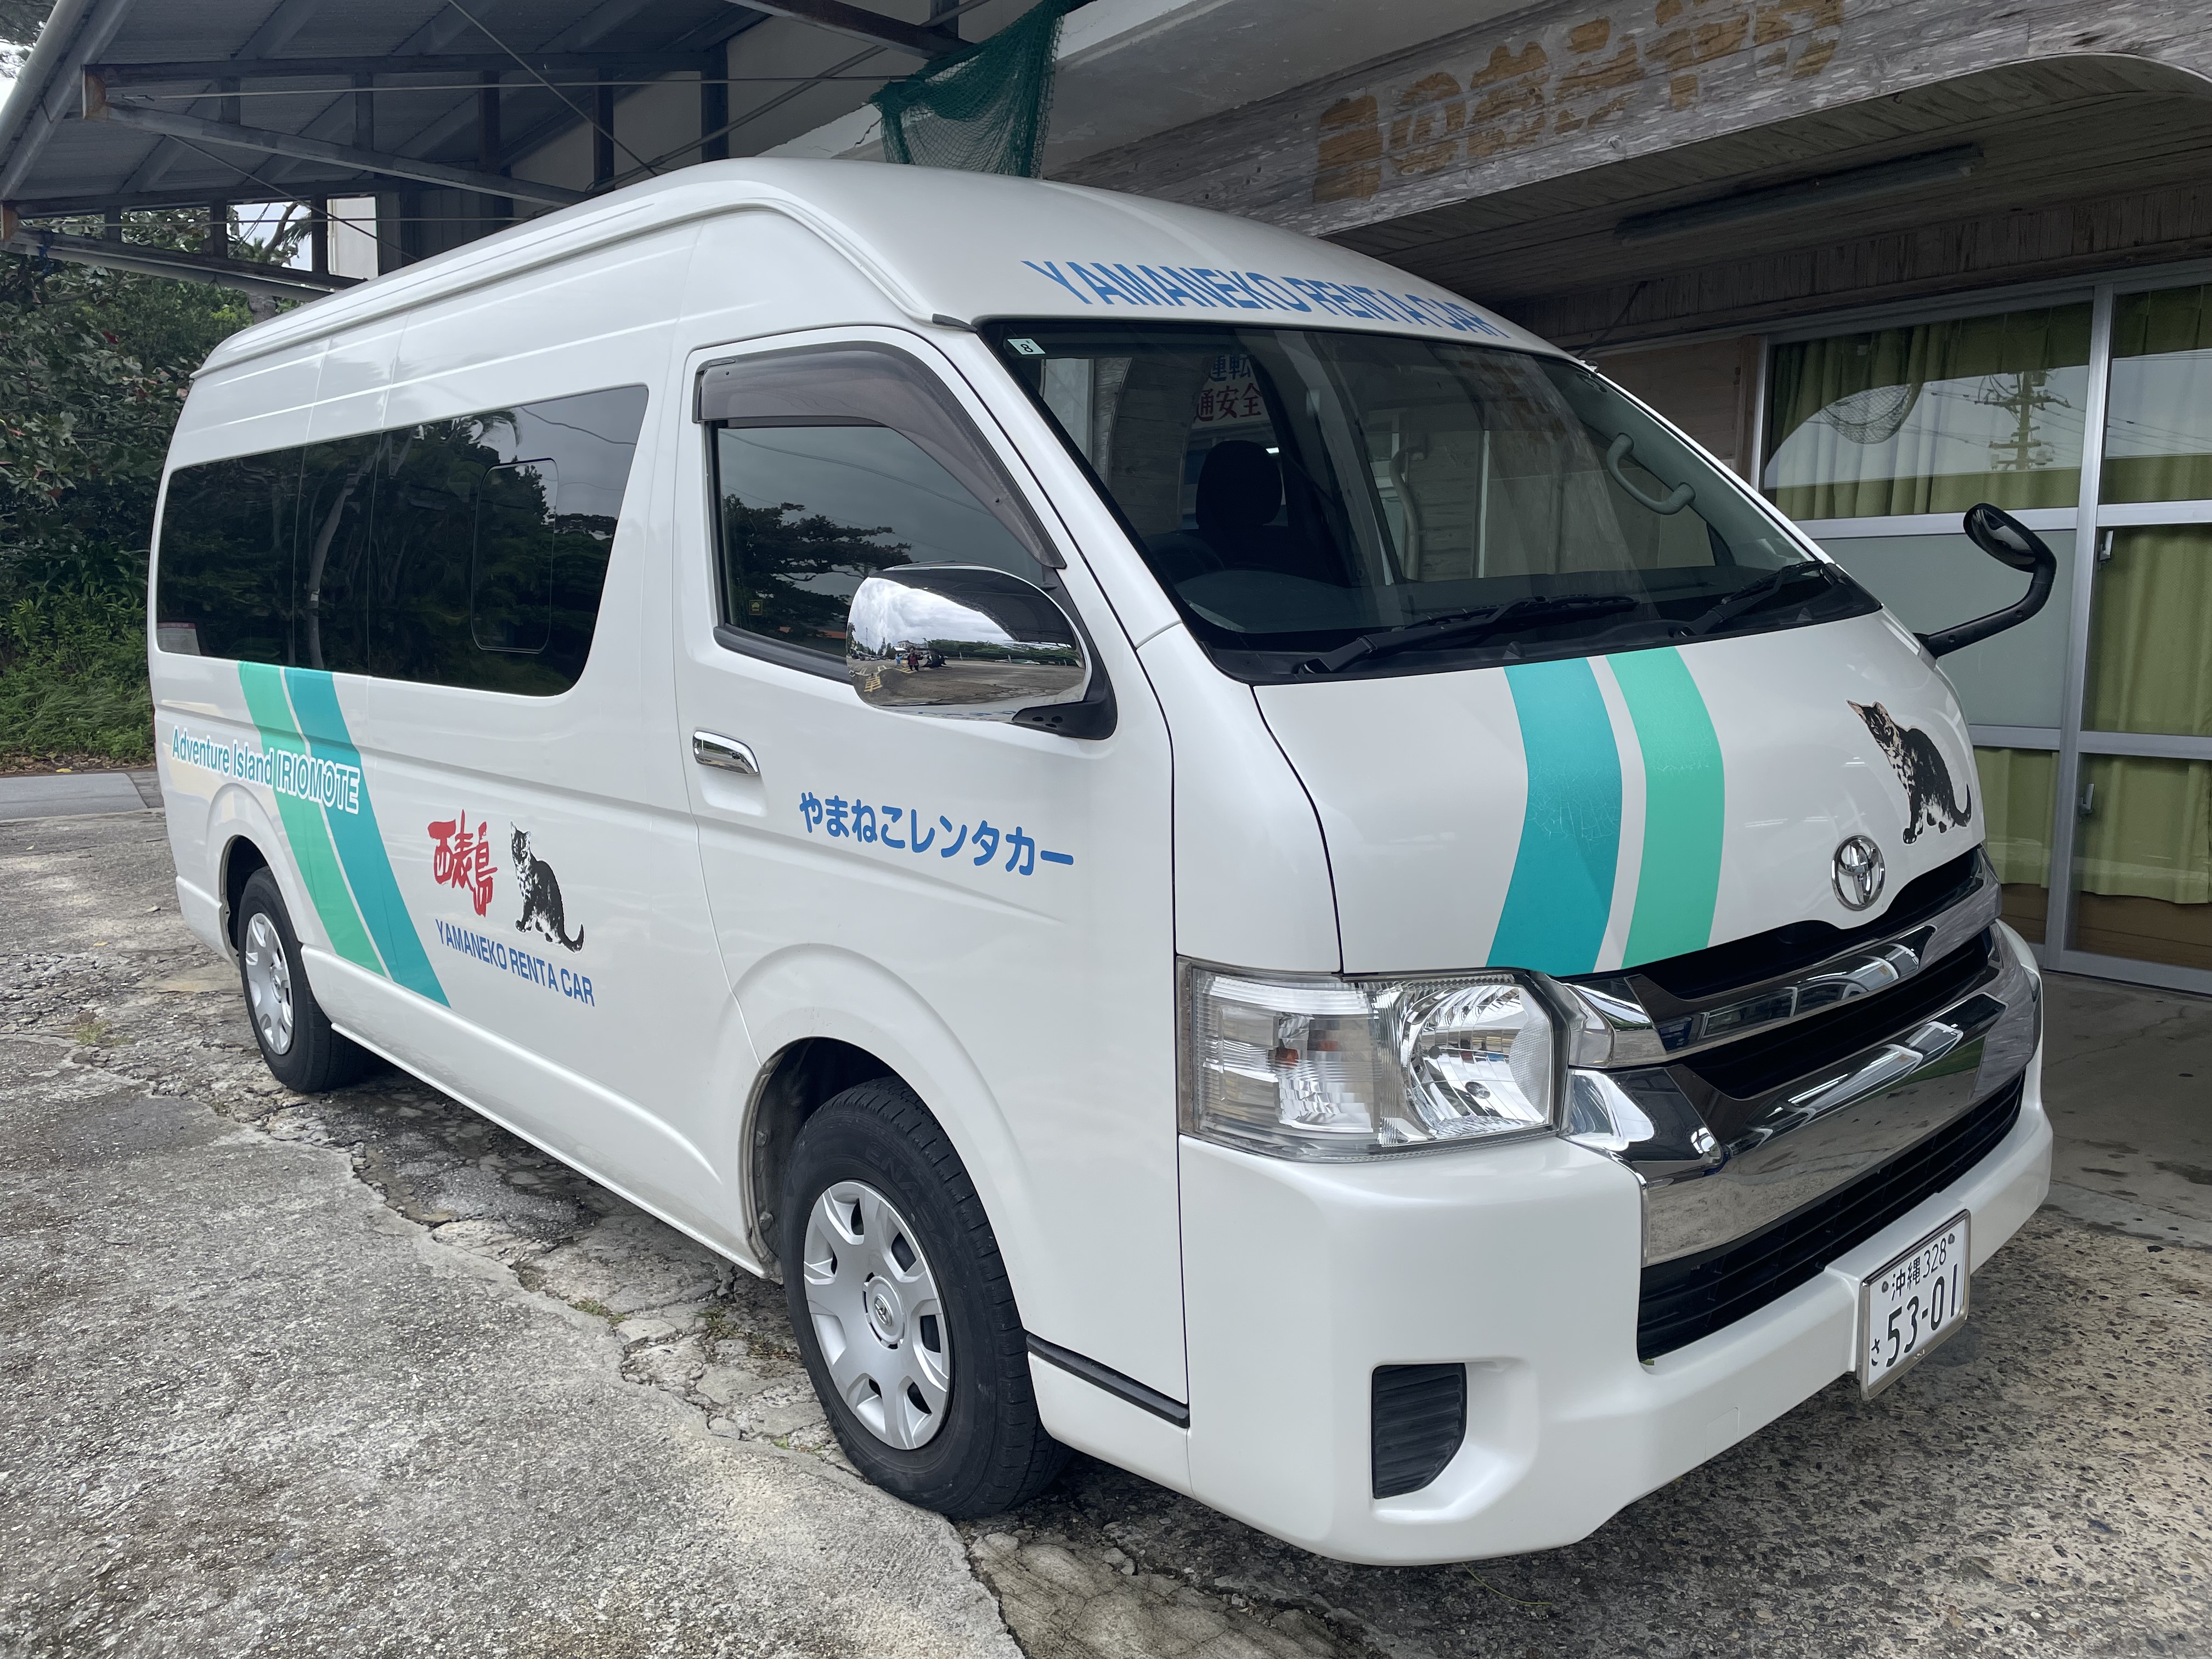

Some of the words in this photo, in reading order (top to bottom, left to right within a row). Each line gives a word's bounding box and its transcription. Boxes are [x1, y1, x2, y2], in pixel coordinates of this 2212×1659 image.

[1020, 261, 1312, 312] YAMANEKO
[1404, 294, 1511, 338] CAR
[1020, 343, 1034, 352] 8
[171, 726, 230, 775] Adventure
[233, 742, 274, 786] Island
[276, 751, 359, 813] IRIOMOTE
[799, 792, 1074, 876] やまねこレンタカー
[435, 919, 507, 970] YAMANEKO
[561, 968, 595, 1007] CAR
[1891, 1256, 1921, 1301] 沖縄
[1923, 1237, 1946, 1278] 328
[1886, 1263, 1957, 1368] 53-01
